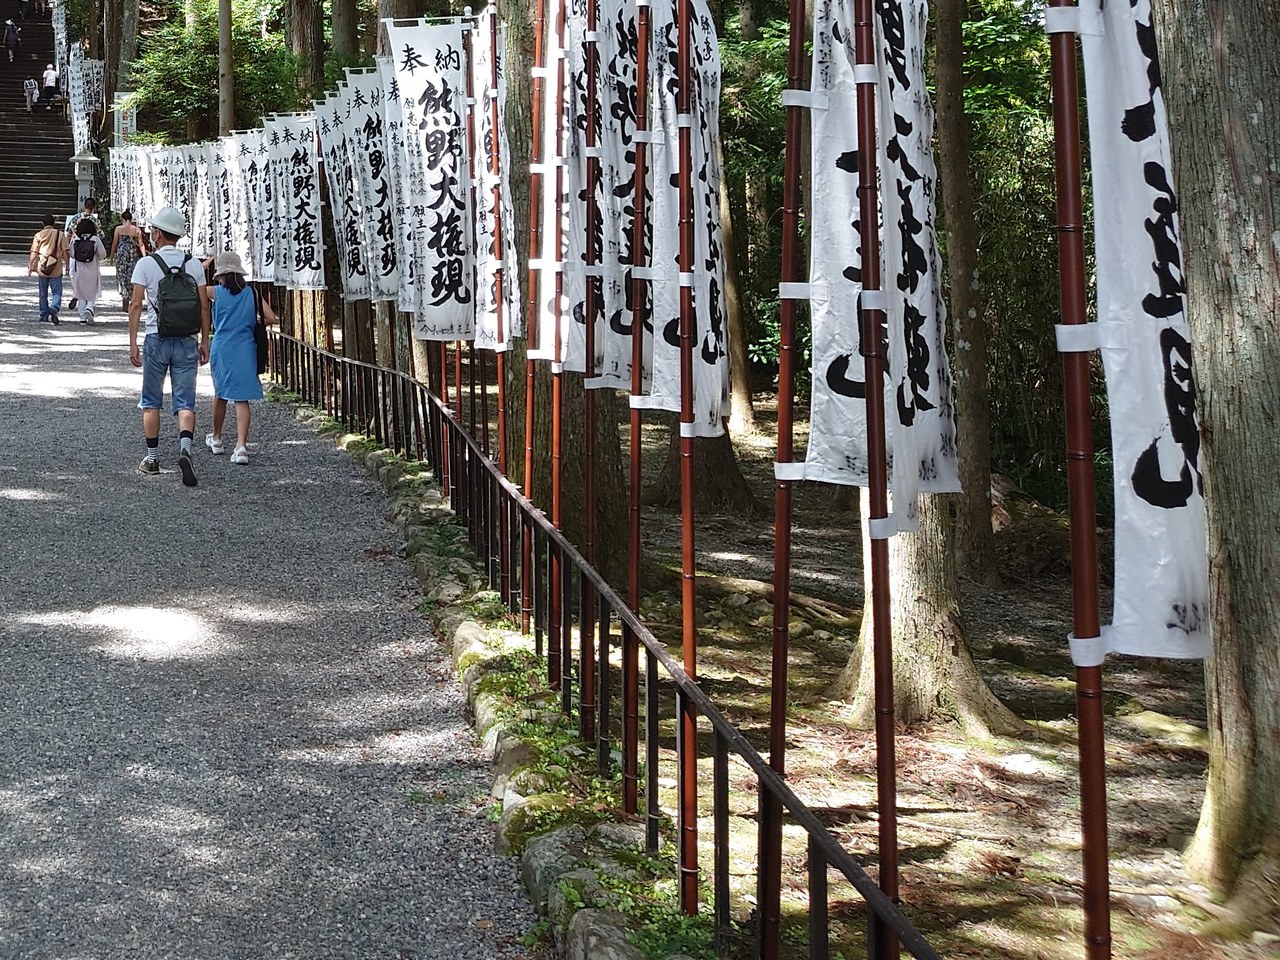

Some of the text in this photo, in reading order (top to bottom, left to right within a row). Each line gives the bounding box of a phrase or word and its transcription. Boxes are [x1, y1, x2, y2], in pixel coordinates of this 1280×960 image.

[399, 43, 461, 77] 奉納
[403, 97, 418, 127] 願意
[290, 145, 321, 273] 熊野大権現
[418, 78, 471, 307] 熊野大権現
[412, 203, 427, 230] 願主
